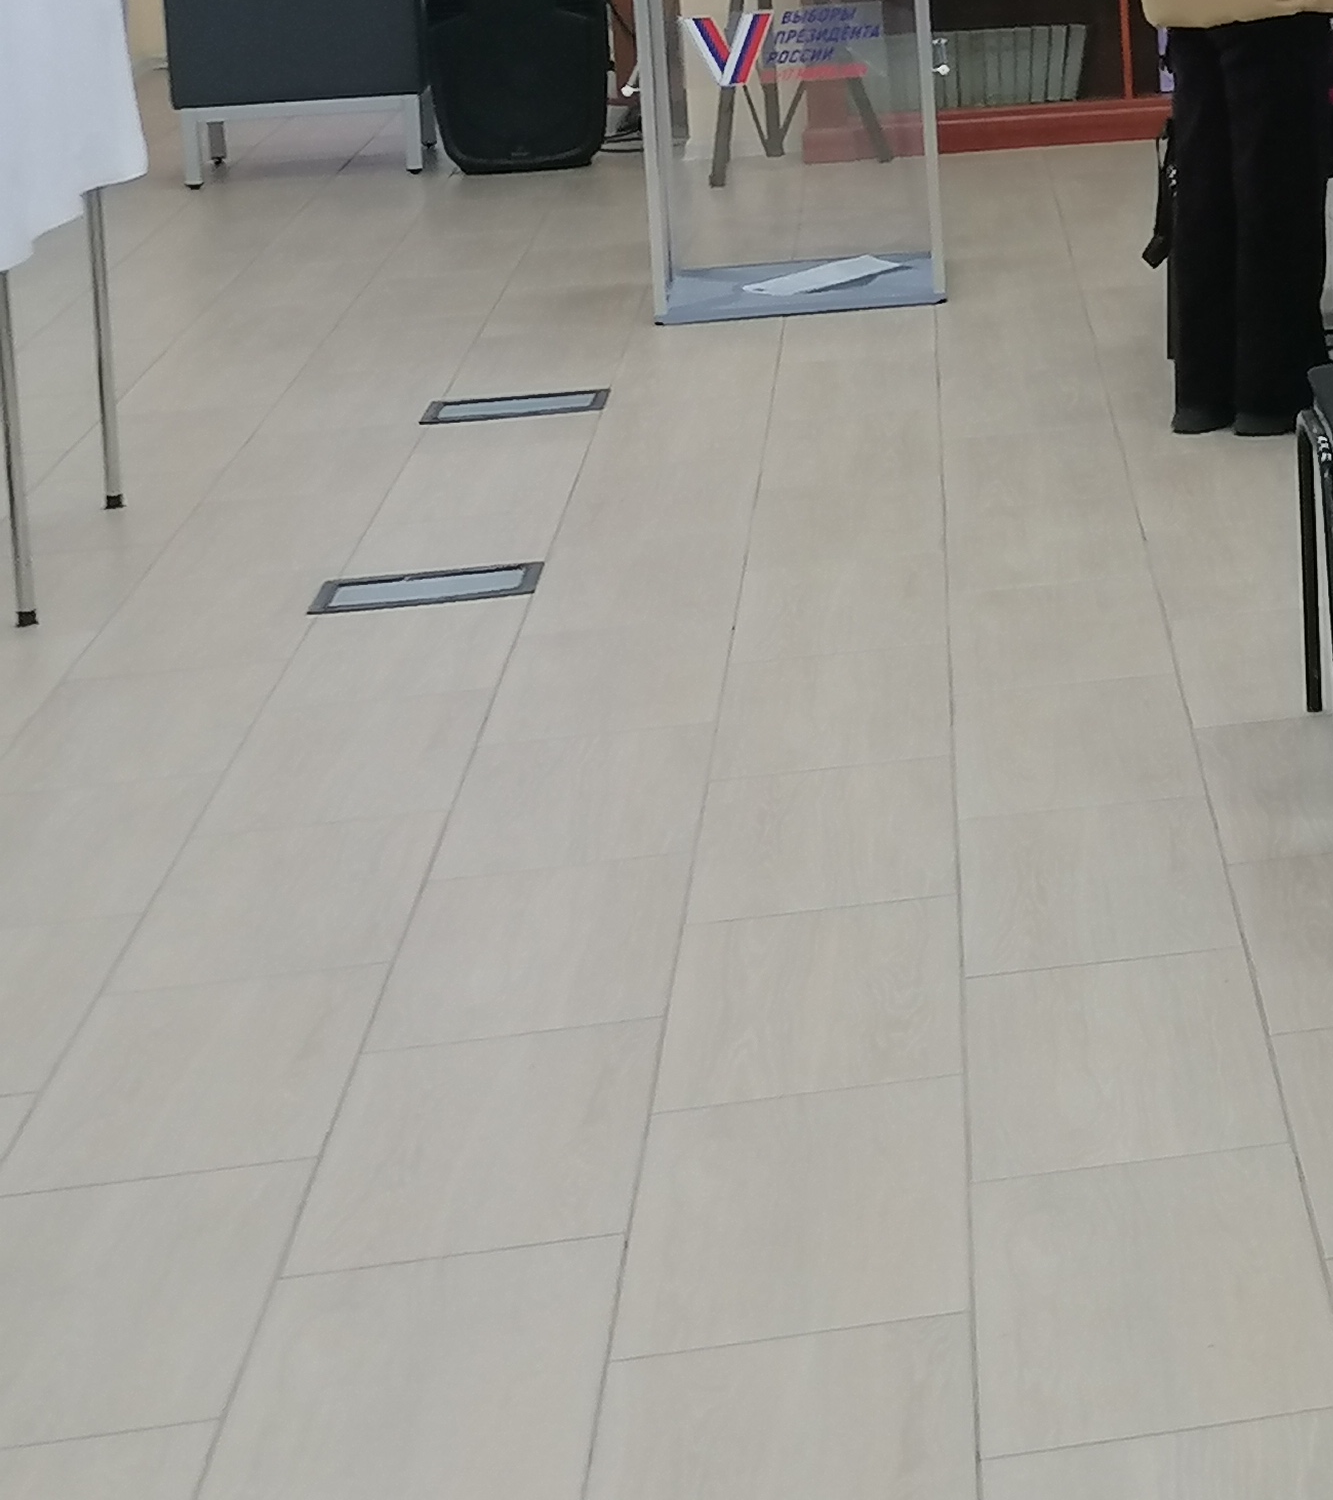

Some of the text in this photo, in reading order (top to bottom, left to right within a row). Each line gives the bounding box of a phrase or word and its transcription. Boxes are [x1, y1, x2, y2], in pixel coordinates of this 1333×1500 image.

[781, 7, 857, 25] ВЫБОРЫ
[774, 25, 880, 44] ПРЕЗИДЕНТА
[766, 48, 834, 65] РОССИИ
